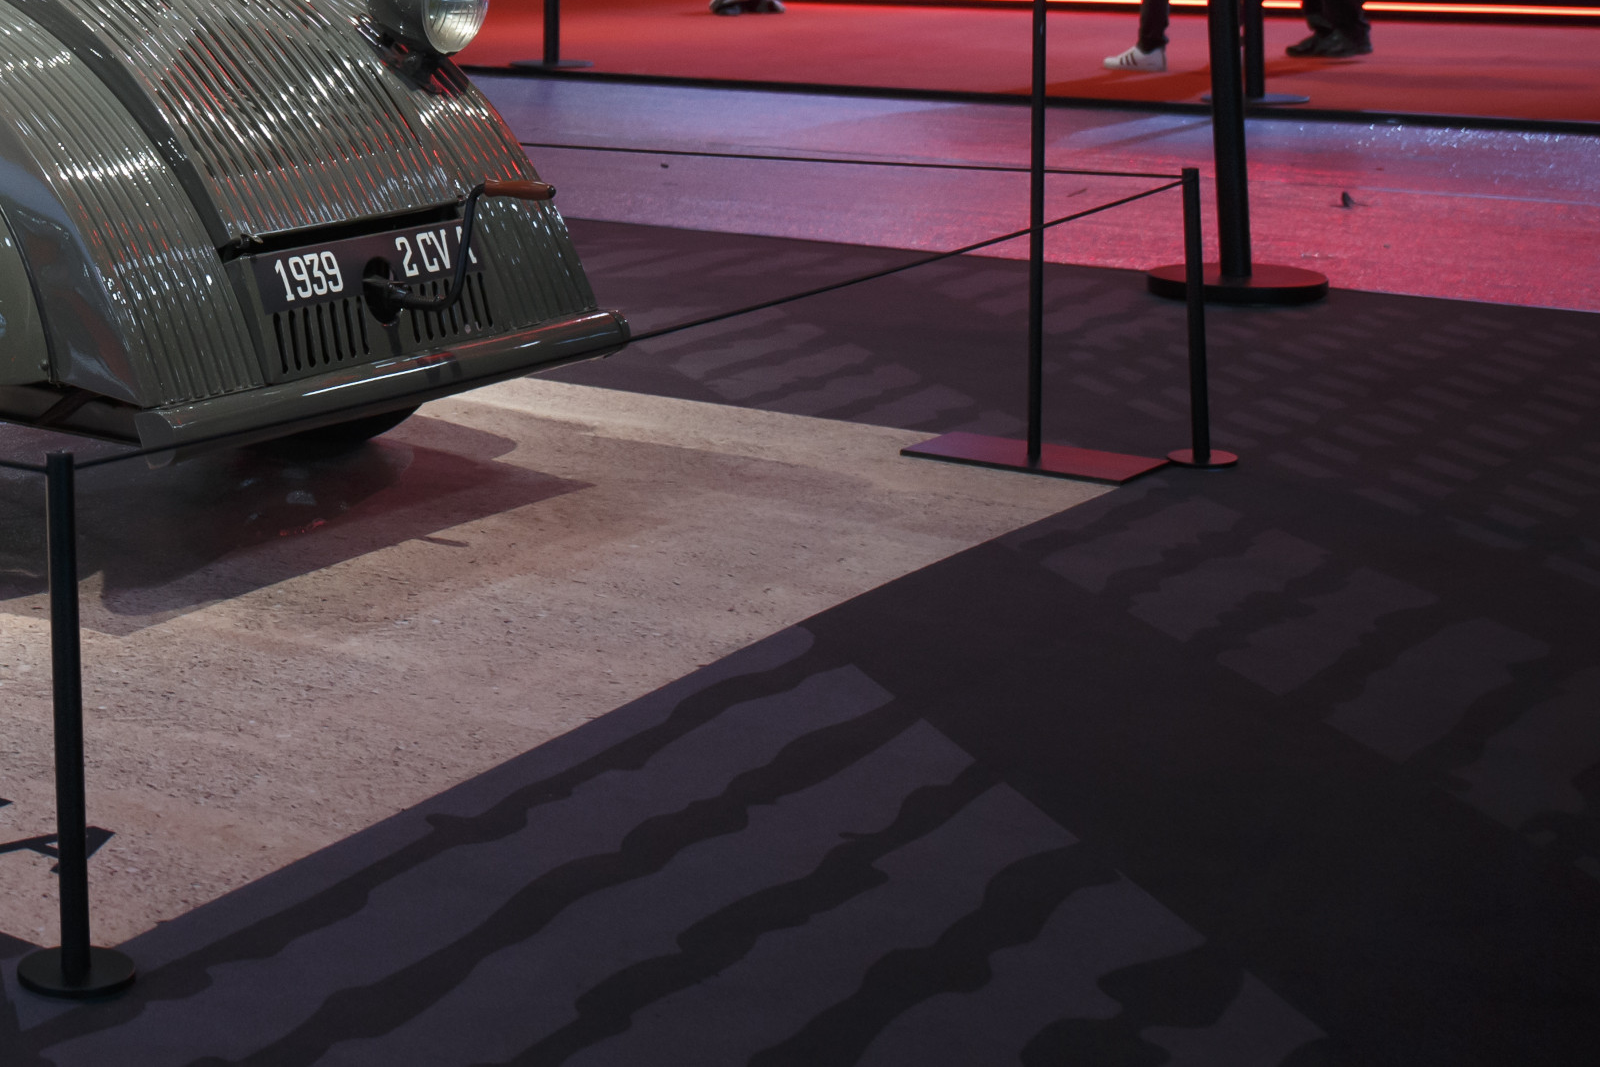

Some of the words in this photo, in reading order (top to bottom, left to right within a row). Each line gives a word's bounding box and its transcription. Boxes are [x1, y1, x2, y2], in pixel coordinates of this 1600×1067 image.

[273, 250, 344, 302] 1939
[395, 236, 420, 278] 2
[416, 228, 451, 273] CV
